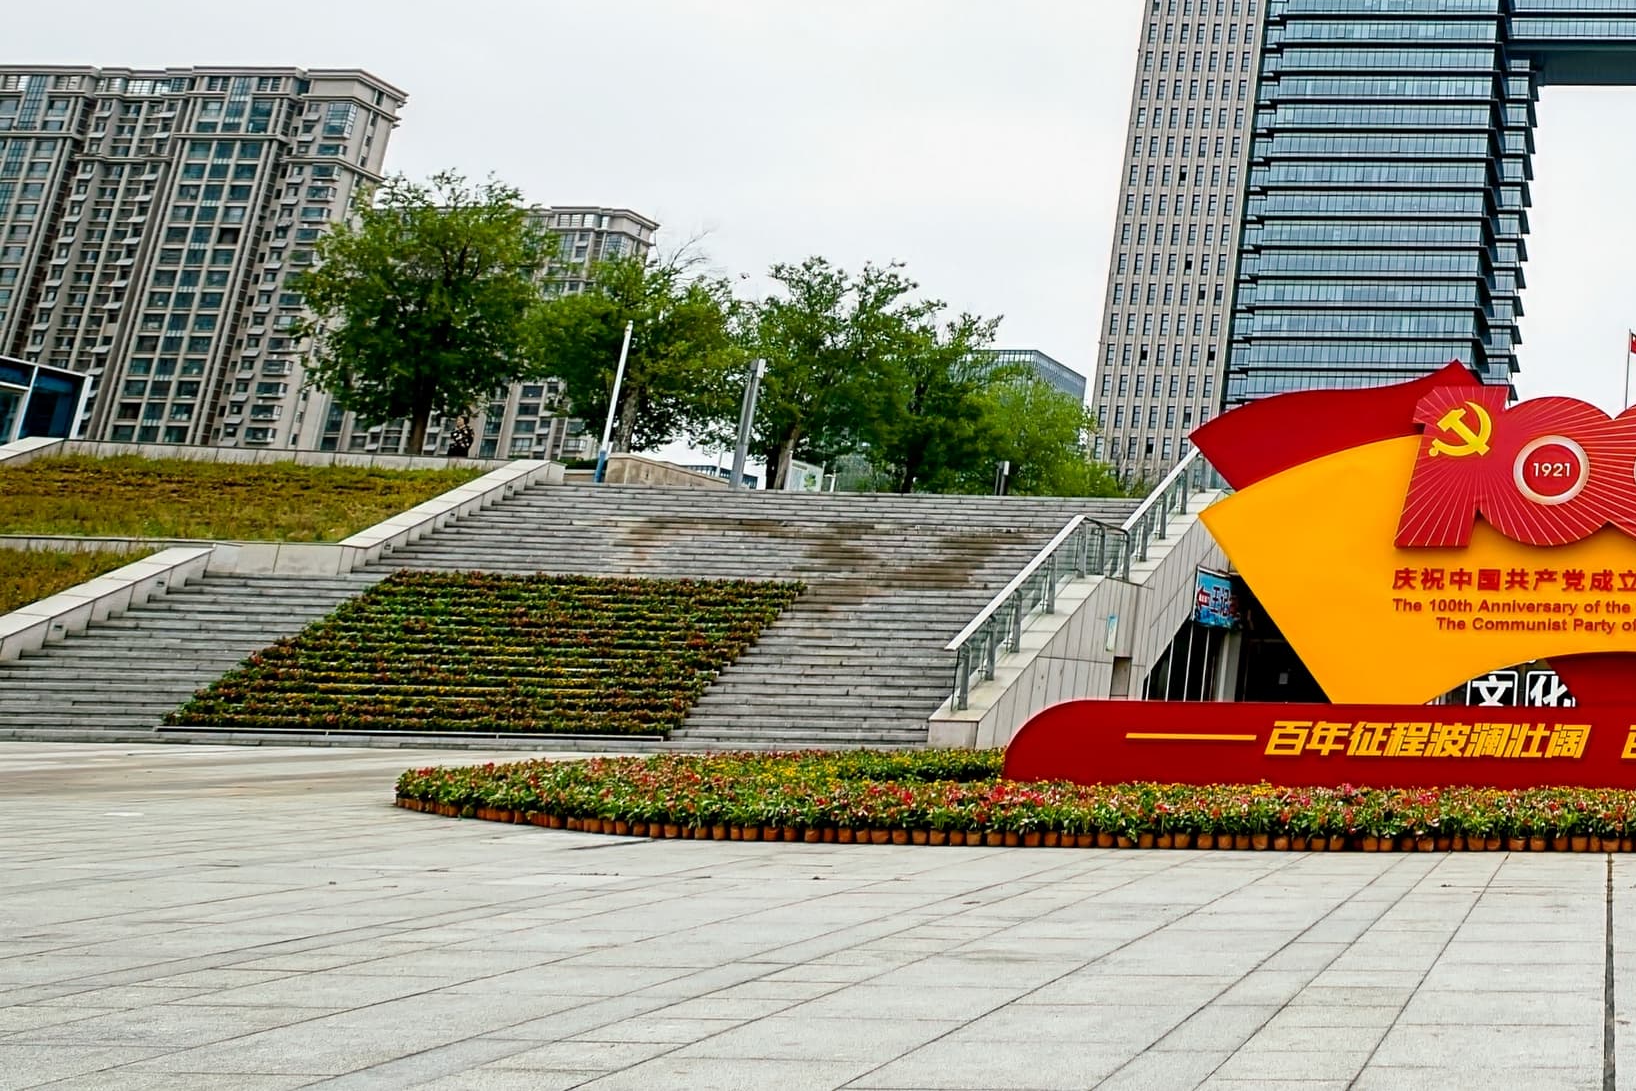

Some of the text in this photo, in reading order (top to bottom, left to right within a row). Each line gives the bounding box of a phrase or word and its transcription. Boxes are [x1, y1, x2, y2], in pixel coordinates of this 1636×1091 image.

[1532, 462, 1571, 477] 1921
[1392, 598, 1422, 612] The
[1429, 598, 1473, 613] 100th
[1478, 599, 1578, 616] Anniversary
[1584, 600, 1601, 614] of
[1605, 600, 1631, 614] the
[1435, 616, 1466, 631] The
[1472, 617, 1568, 632] Communist
[1573, 618, 1616, 635] Party
[1264, 720, 1592, 759] 百年征程波澜壮阔
